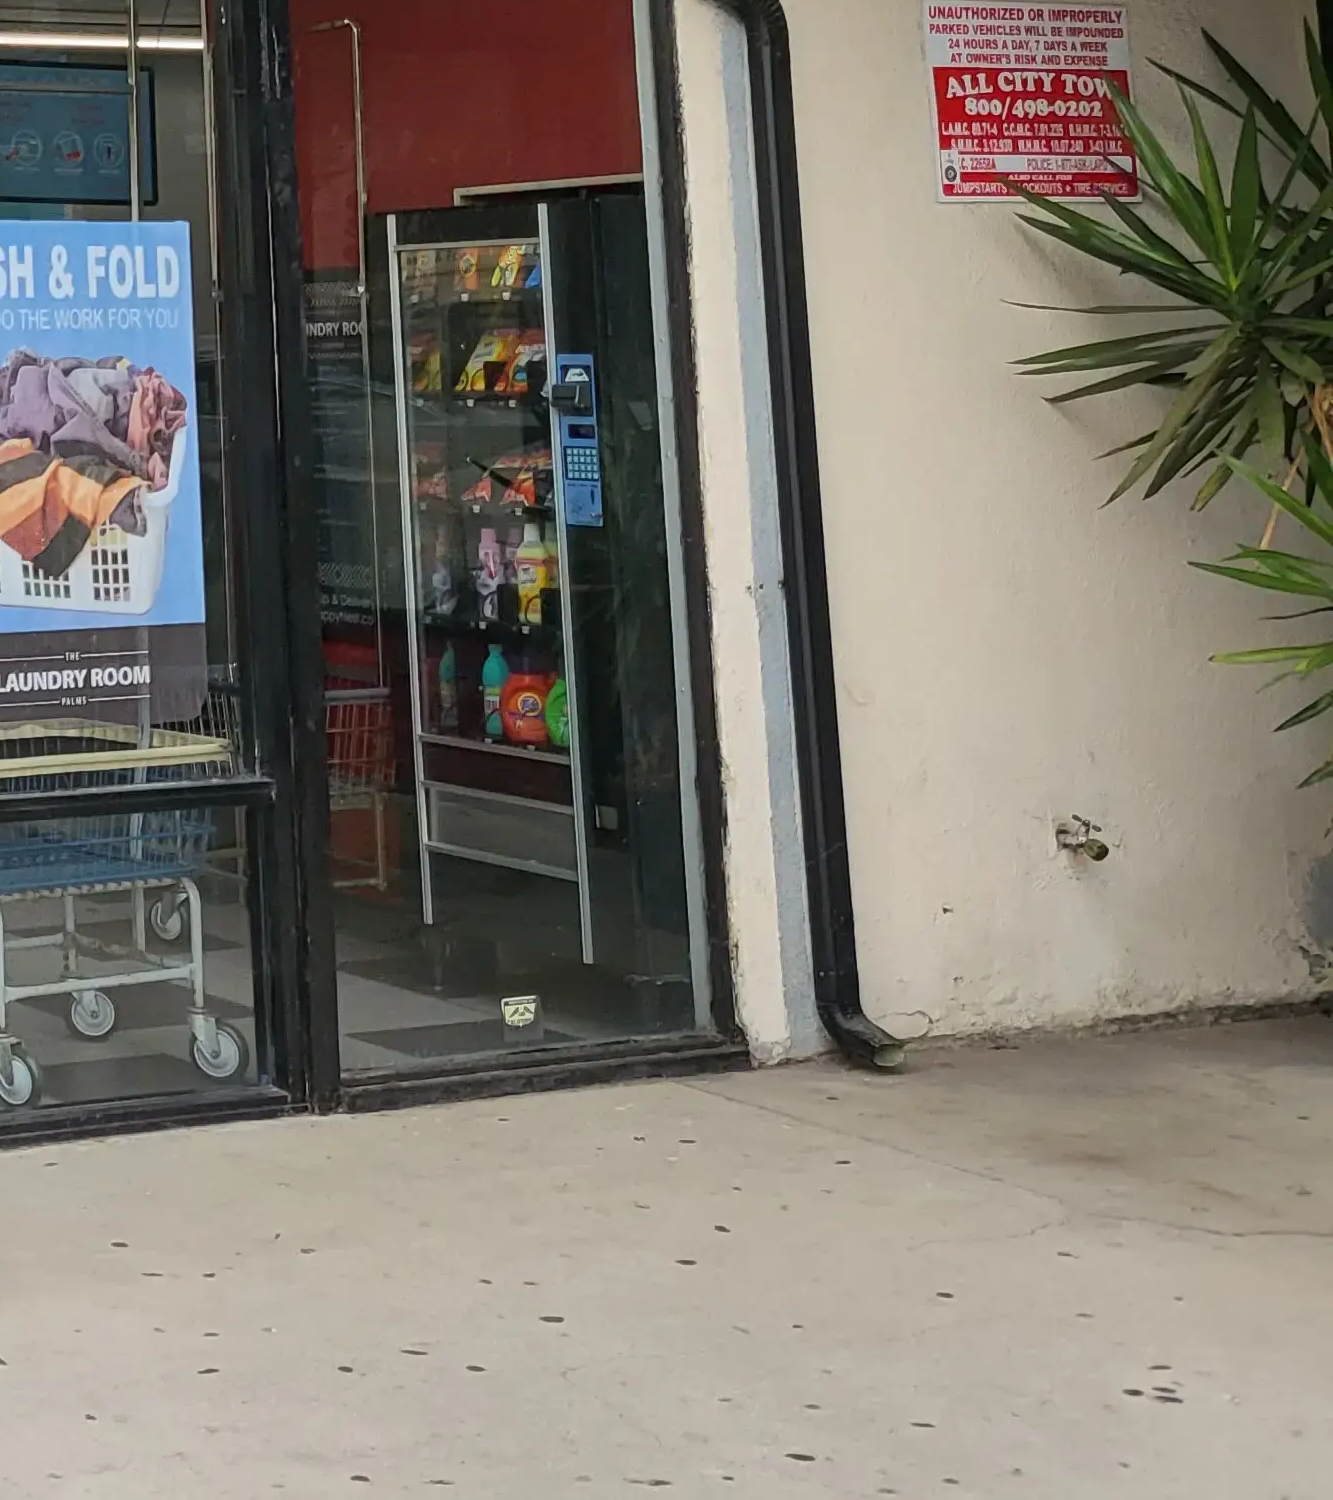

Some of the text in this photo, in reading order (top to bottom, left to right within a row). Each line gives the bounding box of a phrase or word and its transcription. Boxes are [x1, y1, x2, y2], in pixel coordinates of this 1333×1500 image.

[928, 6, 1123, 24] UNAUTHORIZED OR IMPROPERLY
[929, 24, 1124, 39] PARKED VEHICLES WILL BE IMPOUNDED
[948, 38, 1108, 52] 24 HOURS A DAY, 7 DAYS A WEEK
[951, 53, 1108, 66] AT OWNER'S RISK AND EXPENSE
[946, 71, 1118, 100] ALL CITY TOW
[965, 96, 1102, 120] 800/498-0202
[953, 182, 1007, 193] JUMPSTARTS
[48, 244, 75, 299] &
[87, 244, 180, 299] FOLD
[18, 308, 51, 331] THE
[53, 308, 103, 330] WORK
[109, 308, 141, 330] FOR
[144, 308, 179, 330] YOU
[65, 652, 81, 661] THE
[90, 665, 152, 687] ROOM
[61, 696, 87, 706] PALMS
